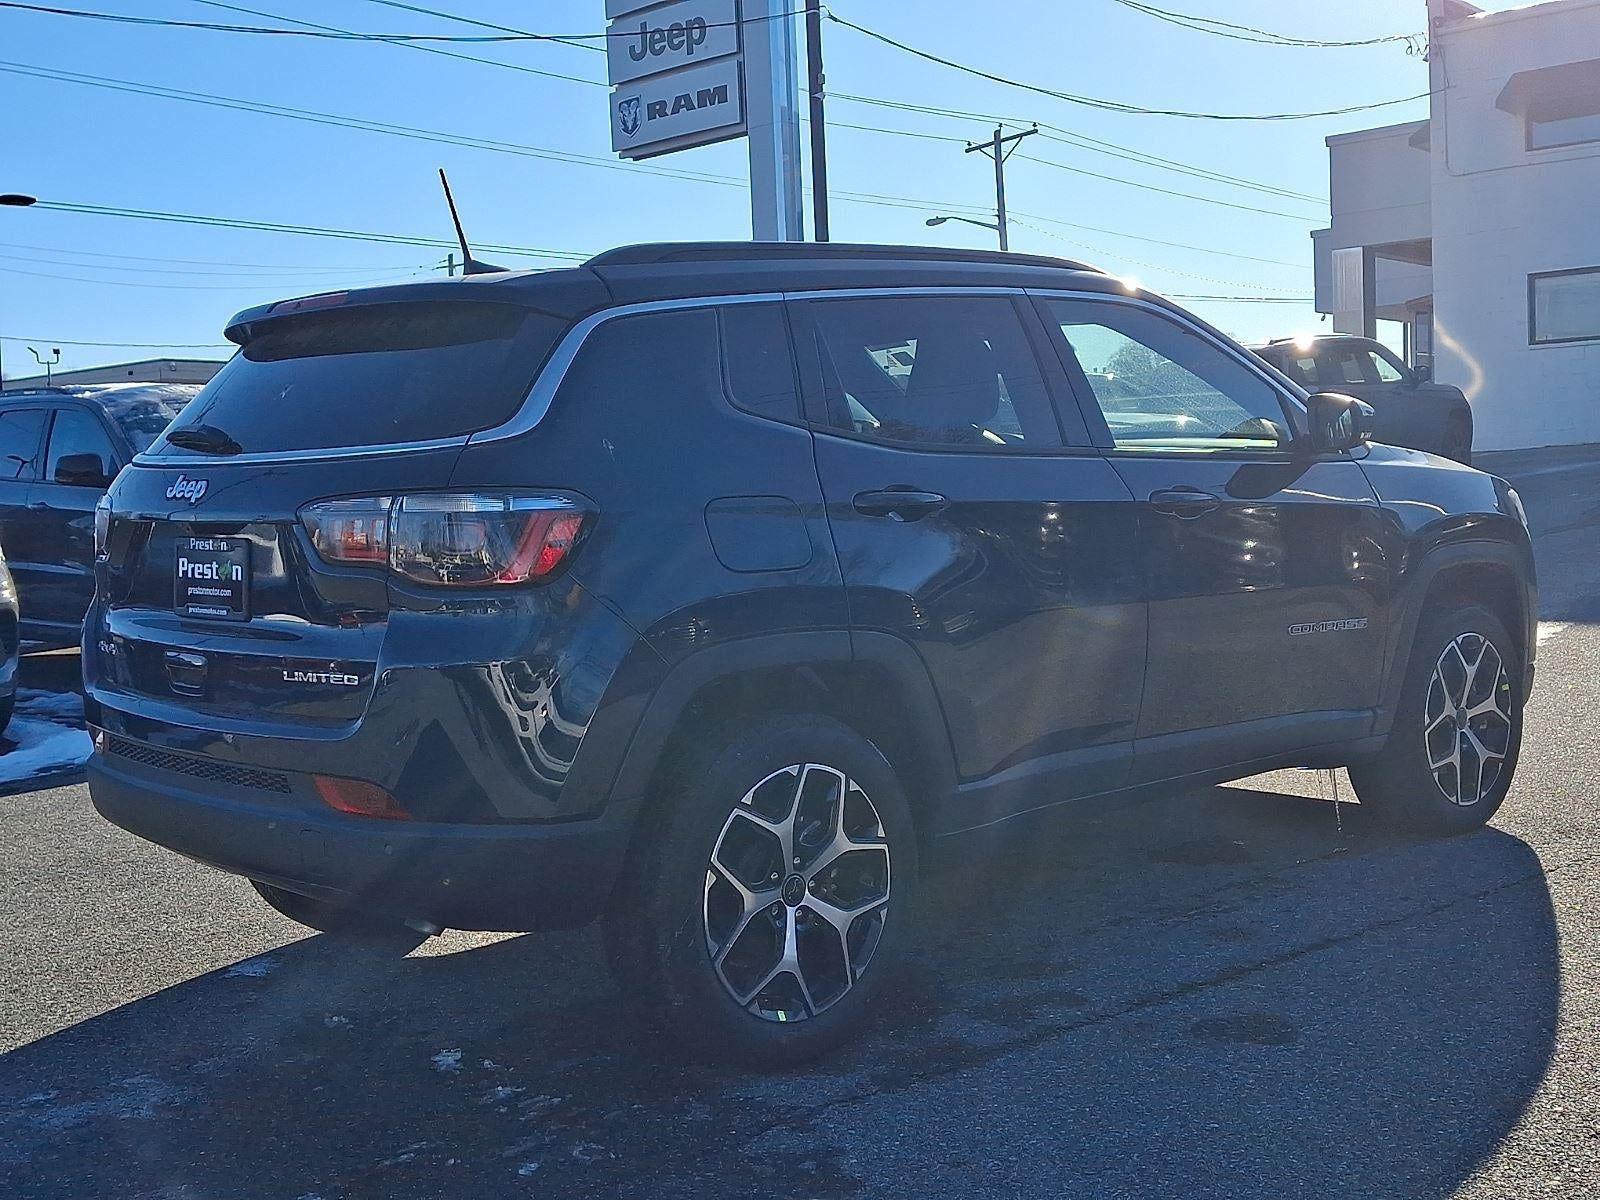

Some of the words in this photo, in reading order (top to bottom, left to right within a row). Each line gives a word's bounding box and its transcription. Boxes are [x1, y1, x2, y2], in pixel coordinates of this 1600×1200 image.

[628, 16, 707, 62] Jeep
[646, 84, 728, 121] RAM
[166, 474, 208, 503] Jeep
[1288, 617, 1368, 636] COMPASS
[282, 670, 359, 686] LIMITED
